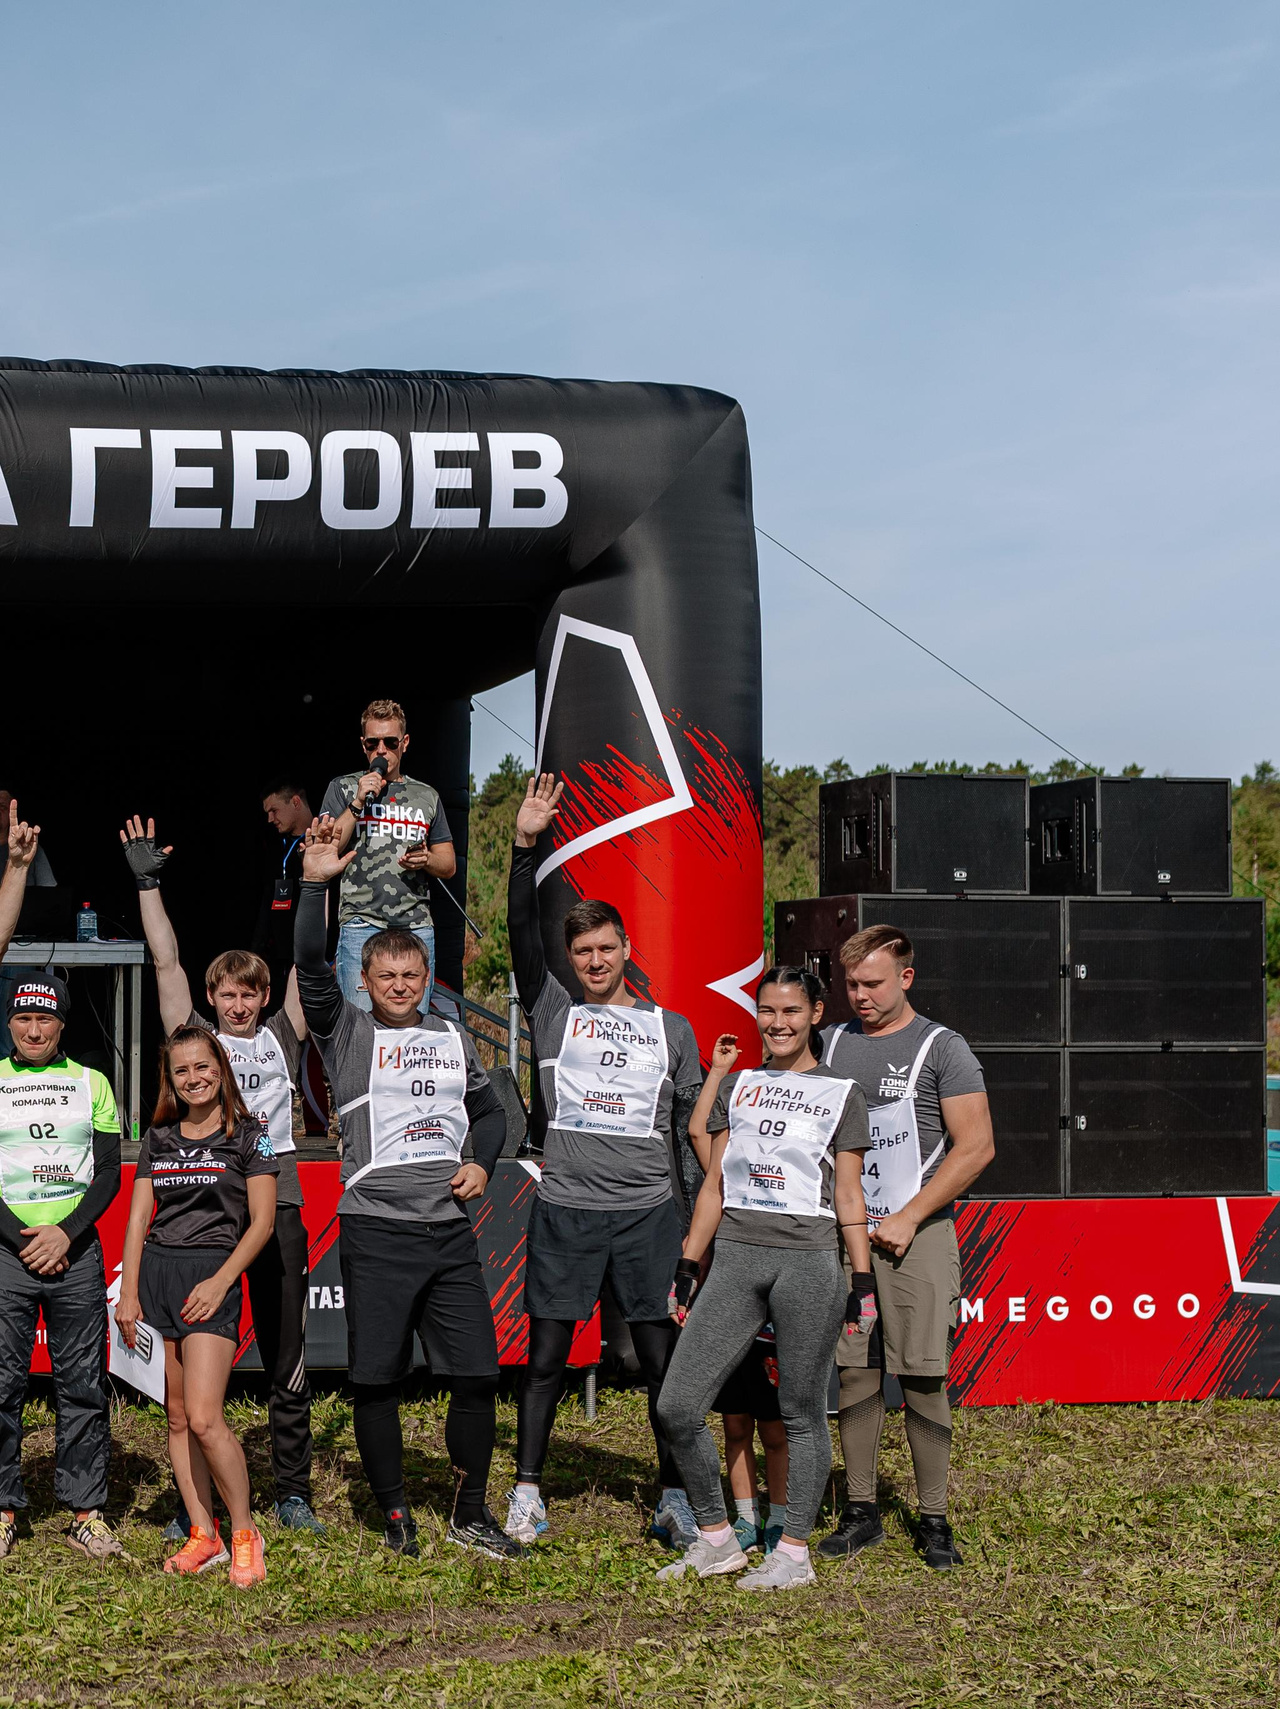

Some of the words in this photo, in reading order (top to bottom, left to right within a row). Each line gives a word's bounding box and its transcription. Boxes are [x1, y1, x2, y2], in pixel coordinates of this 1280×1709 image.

[68, 427, 568, 531] ГЕРОЕВ
[17, 983, 56, 998] ГОНКА
[13, 996, 58, 1010] ГЕРОЕВ
[596, 1019, 632, 1032] УРАЛ
[596, 1030, 659, 1047] ИНТЕРЬЕР
[404, 1046, 437, 1057] УРАЛ
[403, 1058, 461, 1070] ИНТЕРЬЕР
[600, 1050, 628, 1068] 05
[238, 1073, 260, 1089] 10
[411, 1079, 436, 1096] 06
[880, 1077, 908, 1087] ГОНК
[586, 1090, 624, 1102] ГОНКА
[764, 1085, 804, 1101] УРАЛ
[878, 1088, 919, 1099] ГЕРОВ
[60, 1095, 69, 1105] 3
[582, 1102, 626, 1115] ГЕРОЕВ
[758, 1098, 831, 1118] ИНТЕРЬЕР
[28, 1122, 59, 1140] 02
[406, 1119, 442, 1130] ГОНКА
[585, 1121, 627, 1132] ГАЗПРОМБАНК
[758, 1119, 787, 1137] 09
[404, 1131, 445, 1143] ГЕРОЕВ
[871, 1131, 909, 1151] ЕРЬЕР
[411, 1150, 447, 1159] ГАЗПРОМБАНК
[33, 1164, 71, 1173] ГОНКА
[749, 1163, 784, 1176] ГОНКА
[153, 1175, 218, 1187] ИНСТРУКТОР
[748, 1176, 786, 1190] ГЕРОЕВ
[865, 1206, 891, 1216] НКА
[960, 1292, 1201, 1323] MEGOGO
